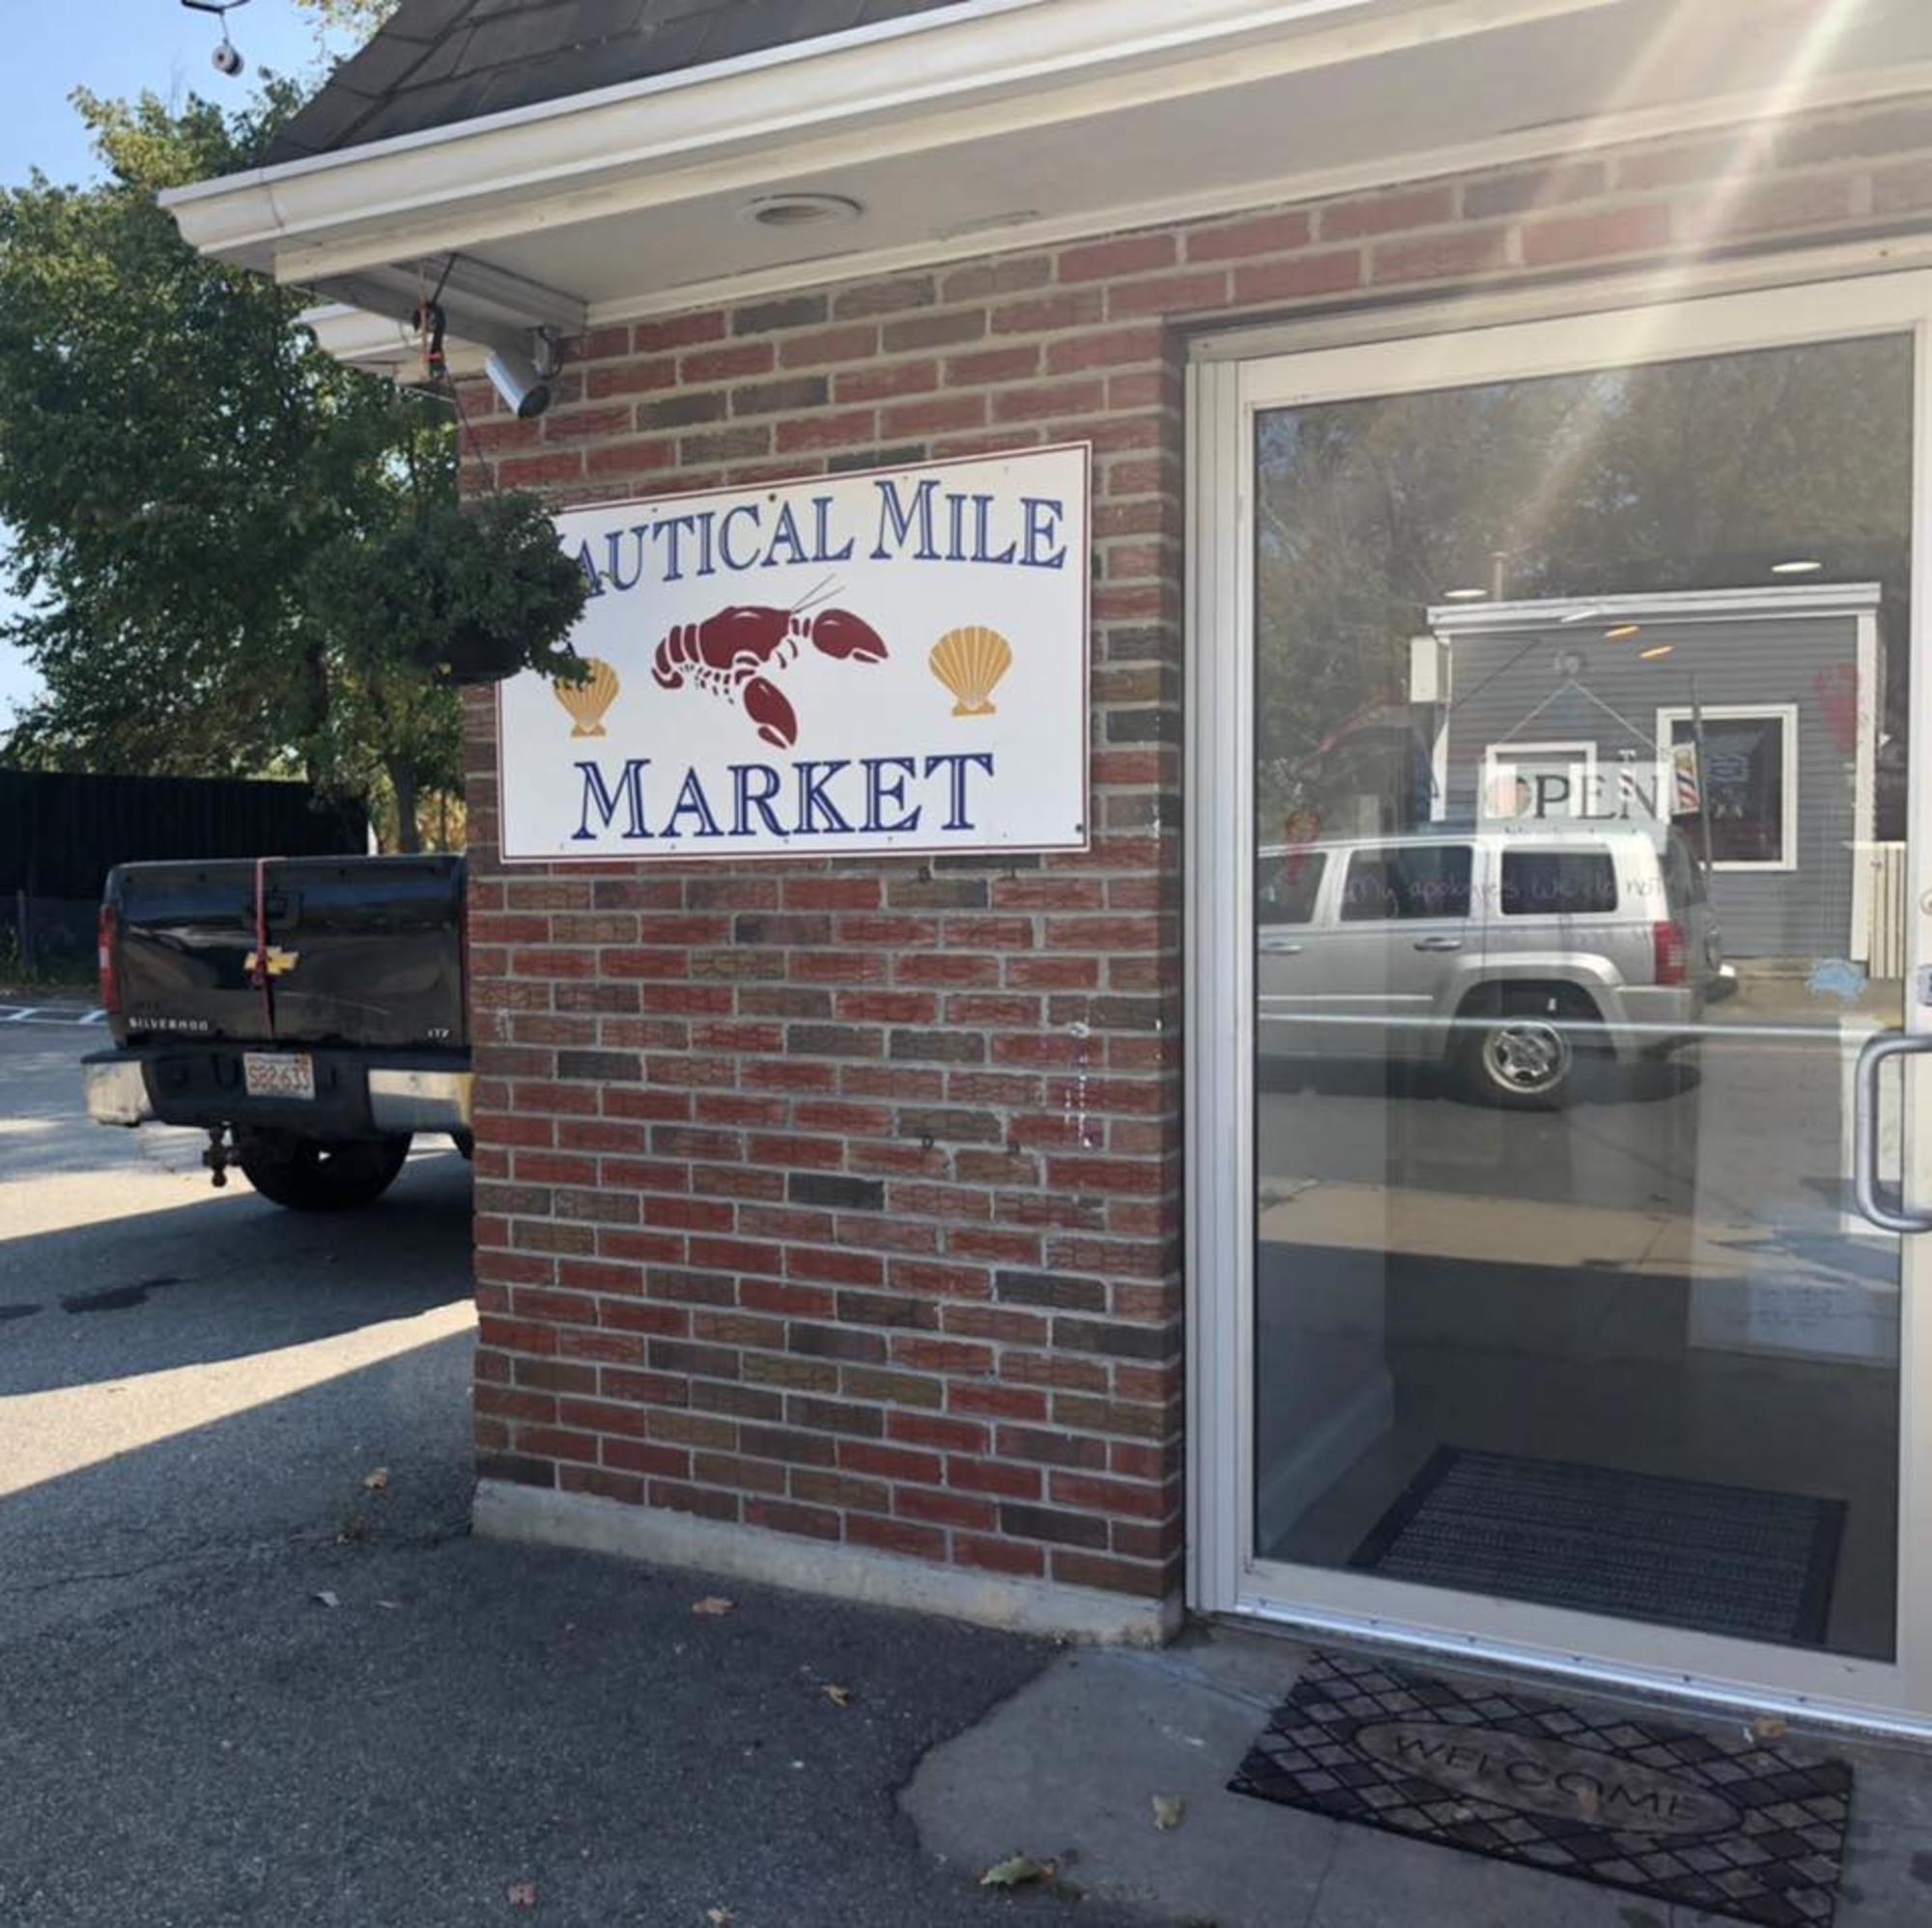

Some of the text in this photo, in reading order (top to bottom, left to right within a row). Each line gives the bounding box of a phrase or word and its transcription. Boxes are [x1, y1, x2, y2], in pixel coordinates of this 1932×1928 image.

[557, 479, 1067, 598] AUTICAL MILE
[571, 751, 995, 840] MARKET
[1395, 1734, 1693, 1819] WELCOME
